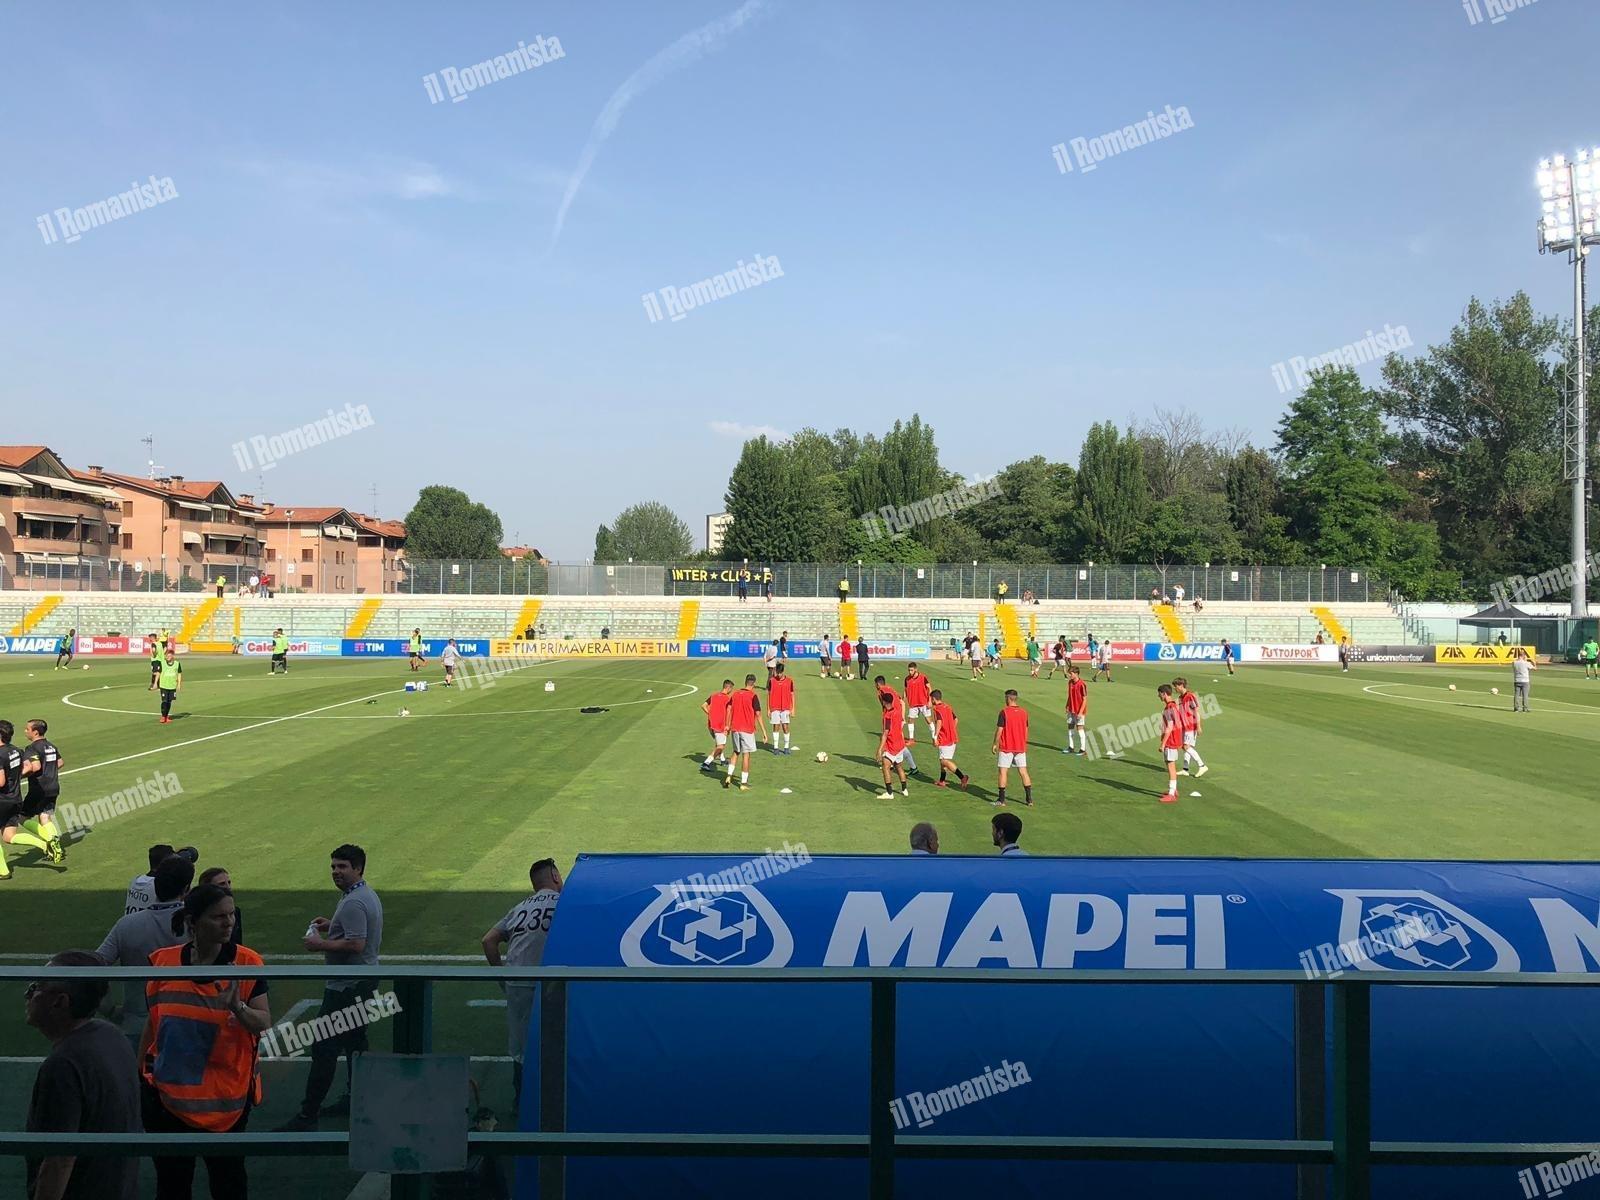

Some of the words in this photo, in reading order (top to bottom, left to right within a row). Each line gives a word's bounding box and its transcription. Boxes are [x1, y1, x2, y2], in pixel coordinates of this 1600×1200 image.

[672, 569, 708, 581] INTER
[11, 638, 59, 652] MAPEI
[94, 641, 117, 649] Radio
[247, 642, 307, 652] Calcori
[366, 643, 384, 652] TIM
[458, 643, 477, 652] TIM
[513, 643, 537, 653] TIM
[540, 642, 612, 654] PRIMAVERA
[615, 643, 638, 653] TIM
[656, 643, 681, 653] TIM
[711, 644, 729, 653] TIM
[1112, 647, 1135, 655] Radio
[1178, 645, 1225, 659] MAPEI
[1261, 646, 1320, 658] TUTTOSPORT
[1441, 647, 1466, 658] FILA
[1473, 647, 1499, 658] FILA
[514, 908, 556, 932] 235
[823, 891, 1226, 968] MAPEI
